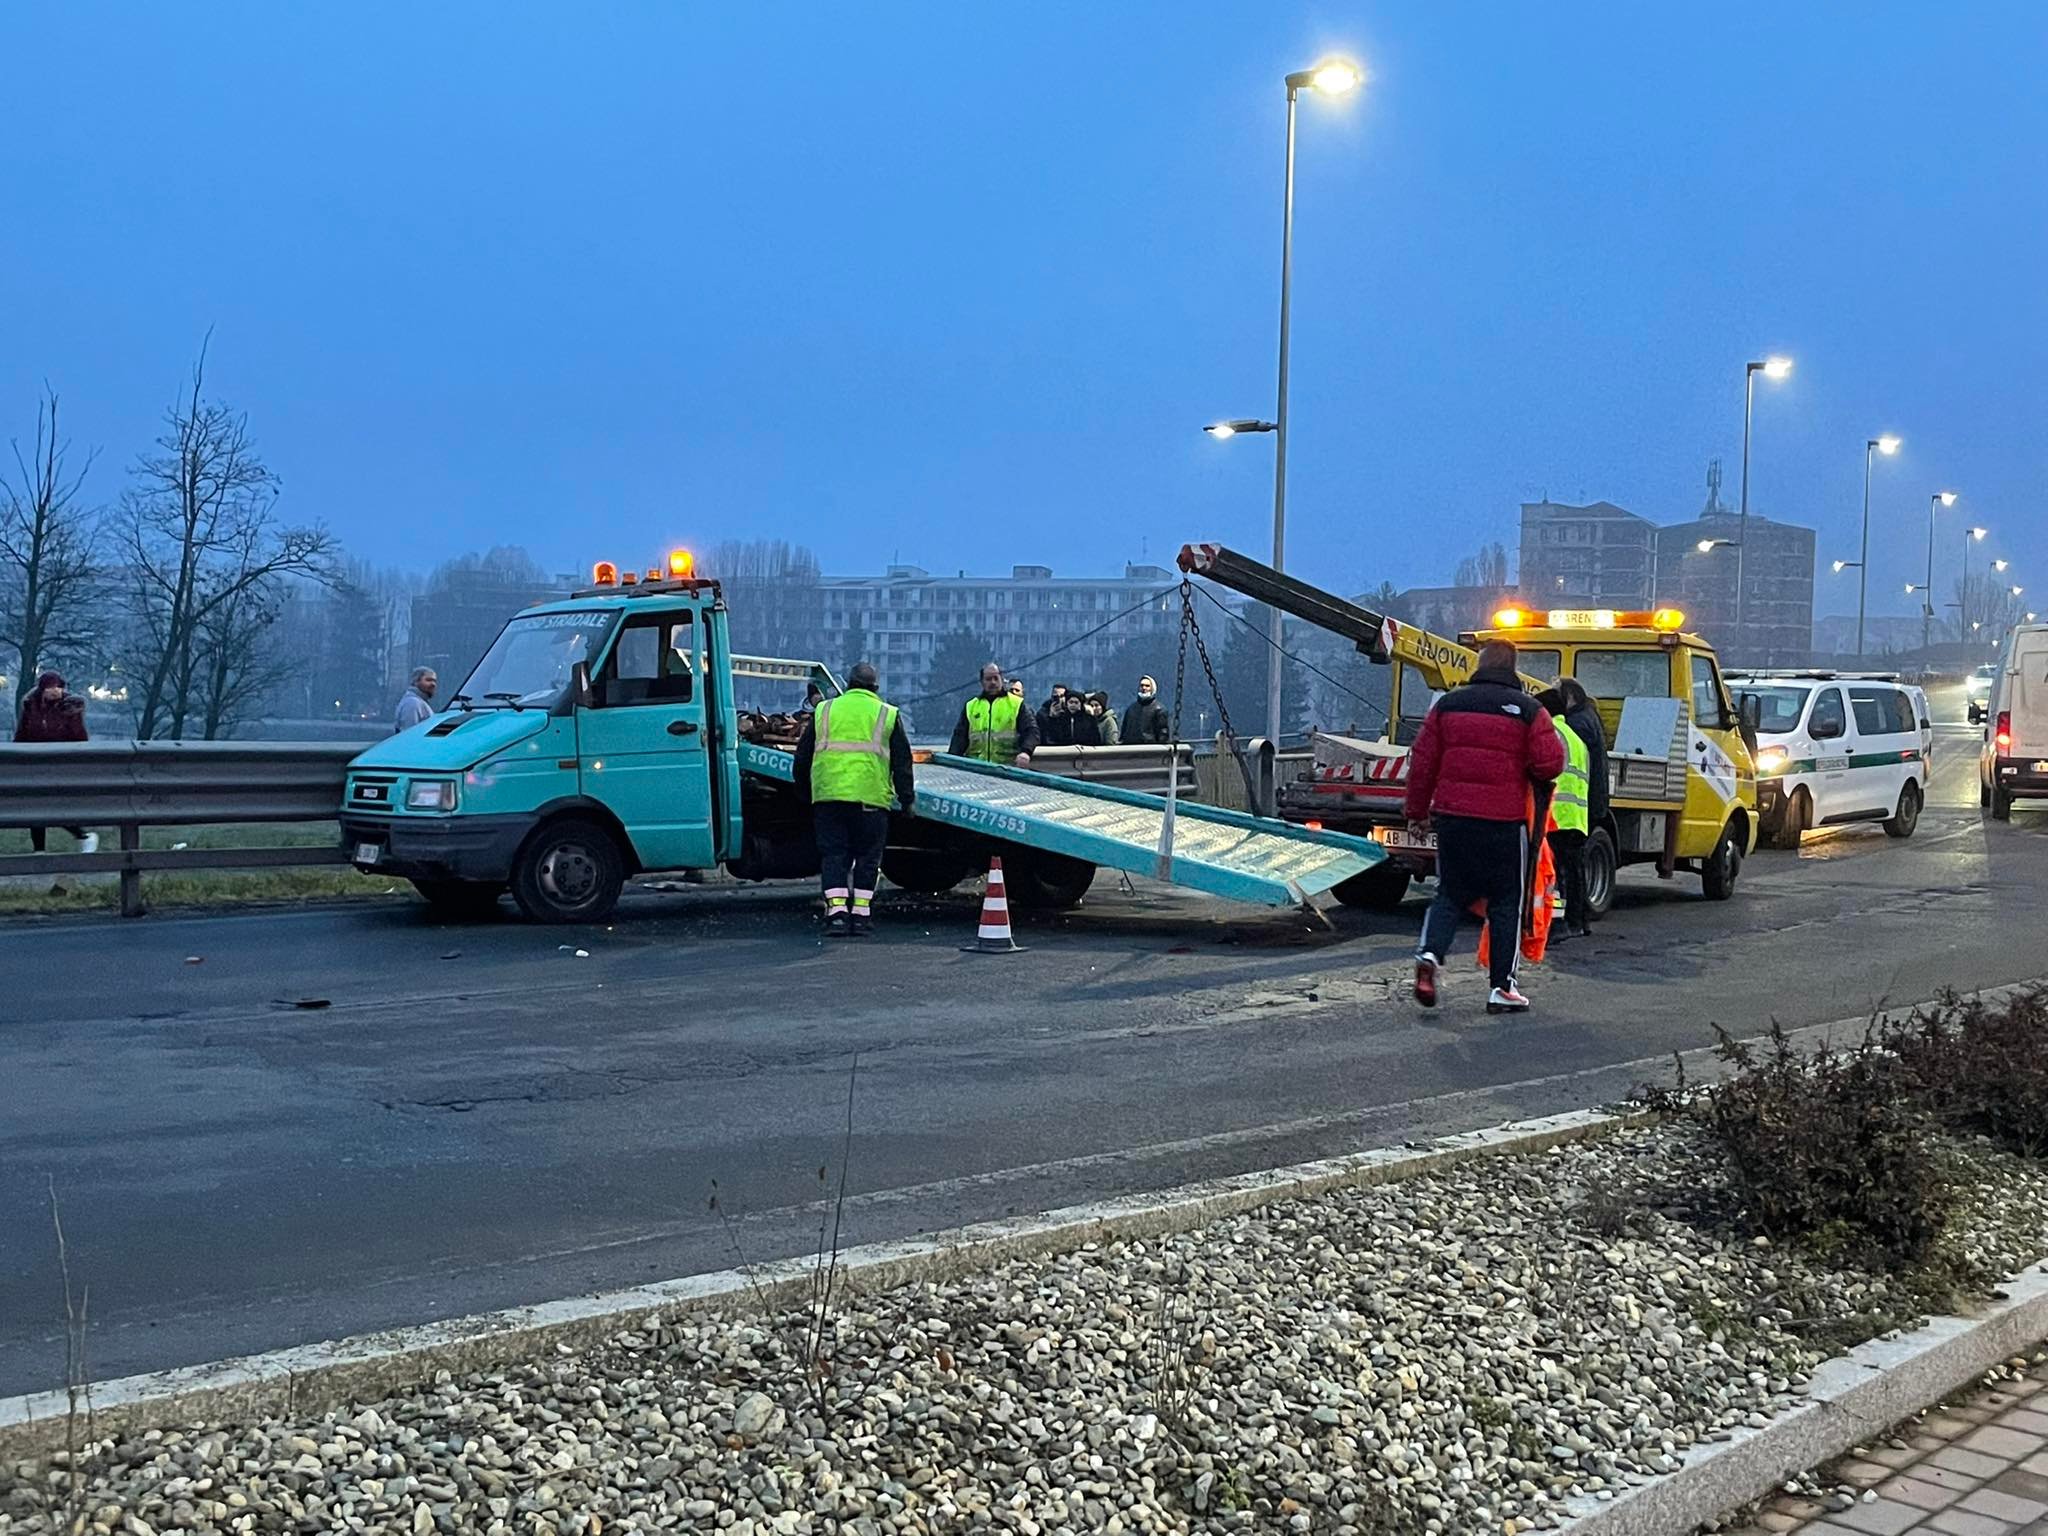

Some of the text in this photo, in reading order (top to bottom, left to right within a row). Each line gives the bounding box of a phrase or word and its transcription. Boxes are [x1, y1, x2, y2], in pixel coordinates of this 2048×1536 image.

[545, 614, 609, 628] STRADALE
[1416, 637, 1468, 672] NUOVA
[1386, 831, 1400, 845] AB
